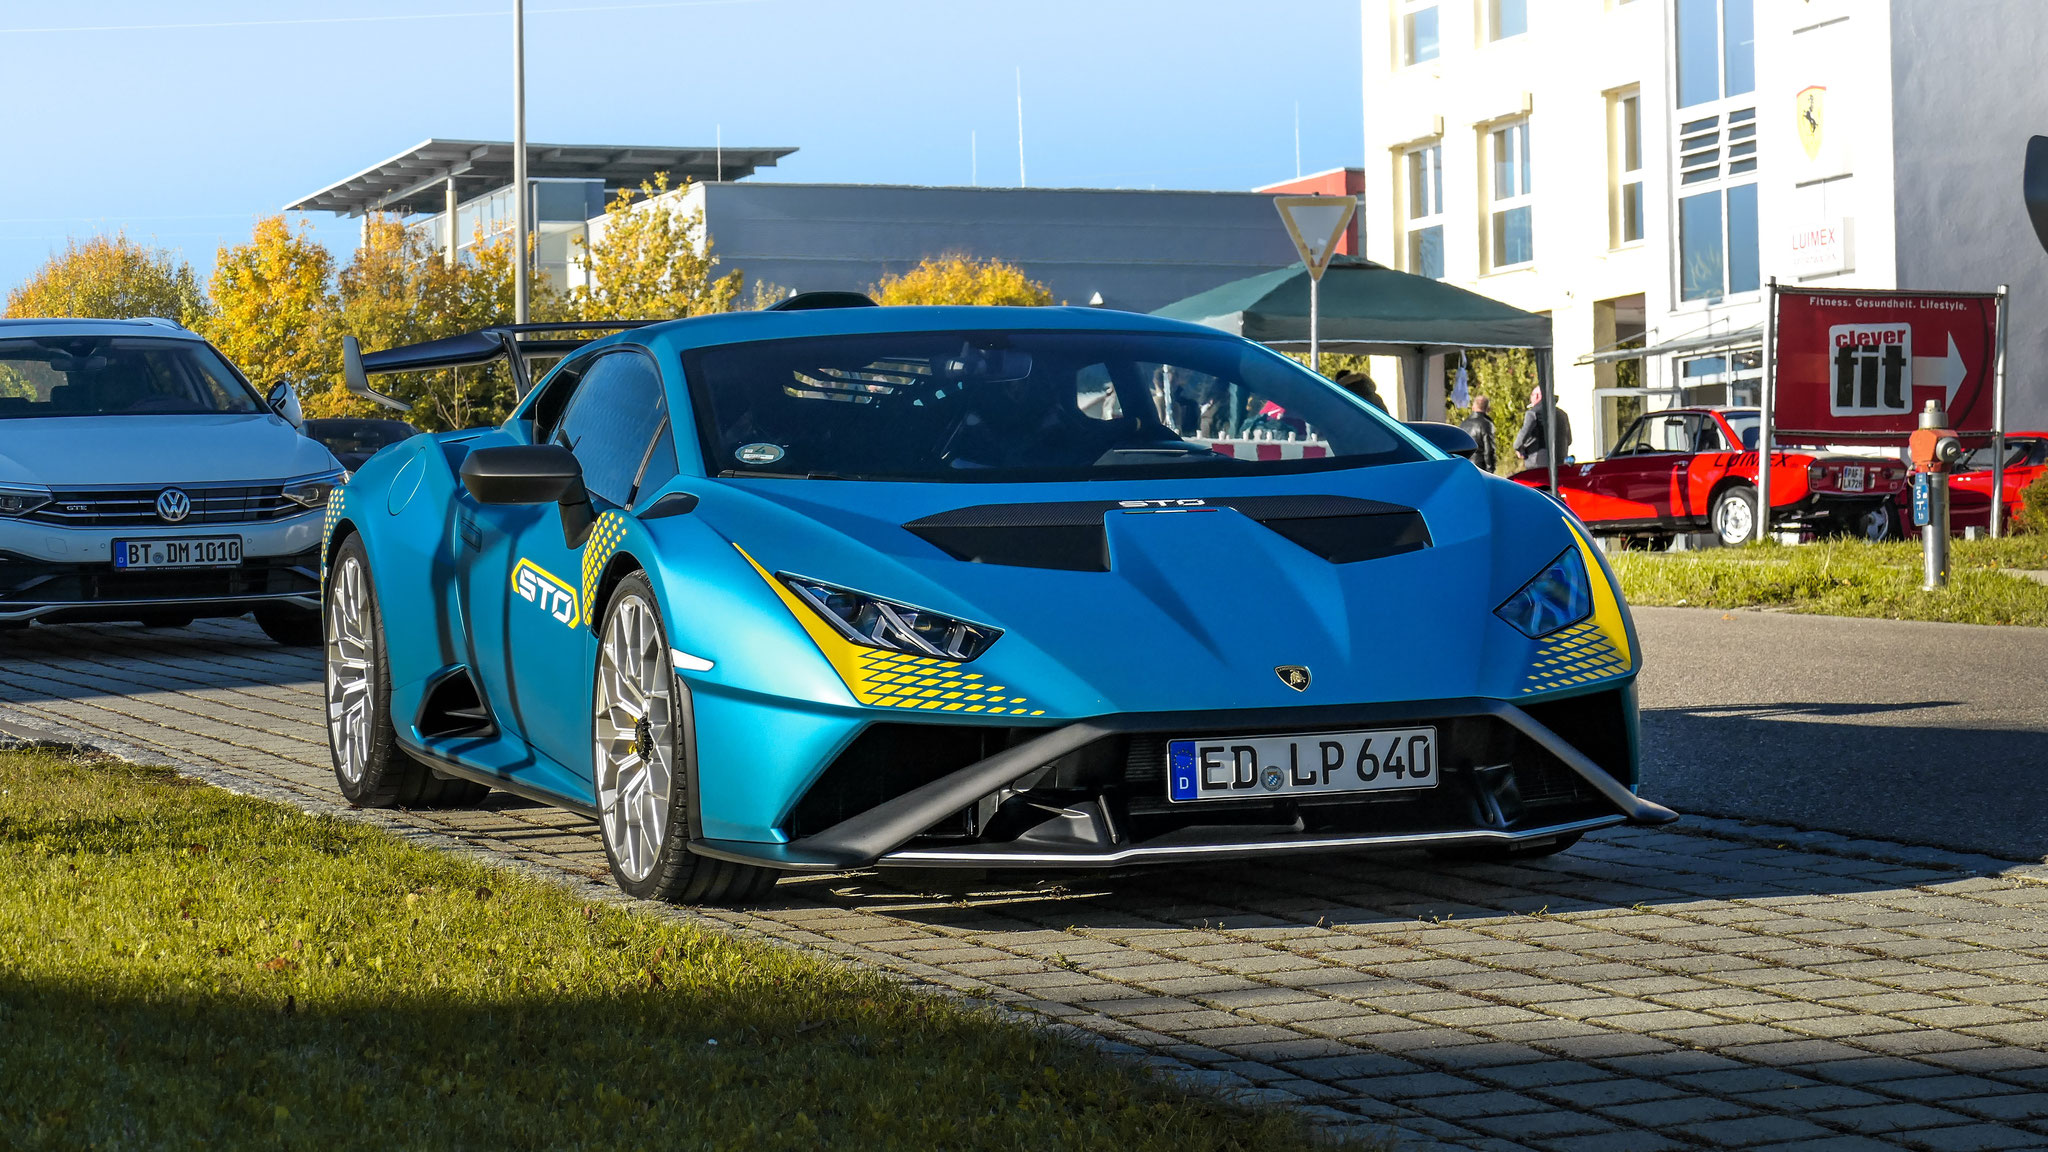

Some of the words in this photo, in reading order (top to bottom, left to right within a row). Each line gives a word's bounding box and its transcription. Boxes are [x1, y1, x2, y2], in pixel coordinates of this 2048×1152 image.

[1792, 228, 1835, 250] LUIMEX
[1809, 296, 1851, 307] Fitness.
[1855, 298, 1916, 309] Gesundheit.
[1920, 299, 1967, 311] Lifestyle.
[1835, 330, 1906, 348] clever
[1834, 344, 1906, 409] fit
[1118, 499, 1205, 507] STO
[128, 544, 151, 564] BT
[166, 543, 190, 563] DM
[194, 541, 238, 562] 1010
[519, 568, 573, 623] STO
[1179, 777, 1188, 789] D
[1200, 745, 1258, 790] ED
[1289, 741, 1344, 786] LP
[1356, 735, 1430, 782] 640
